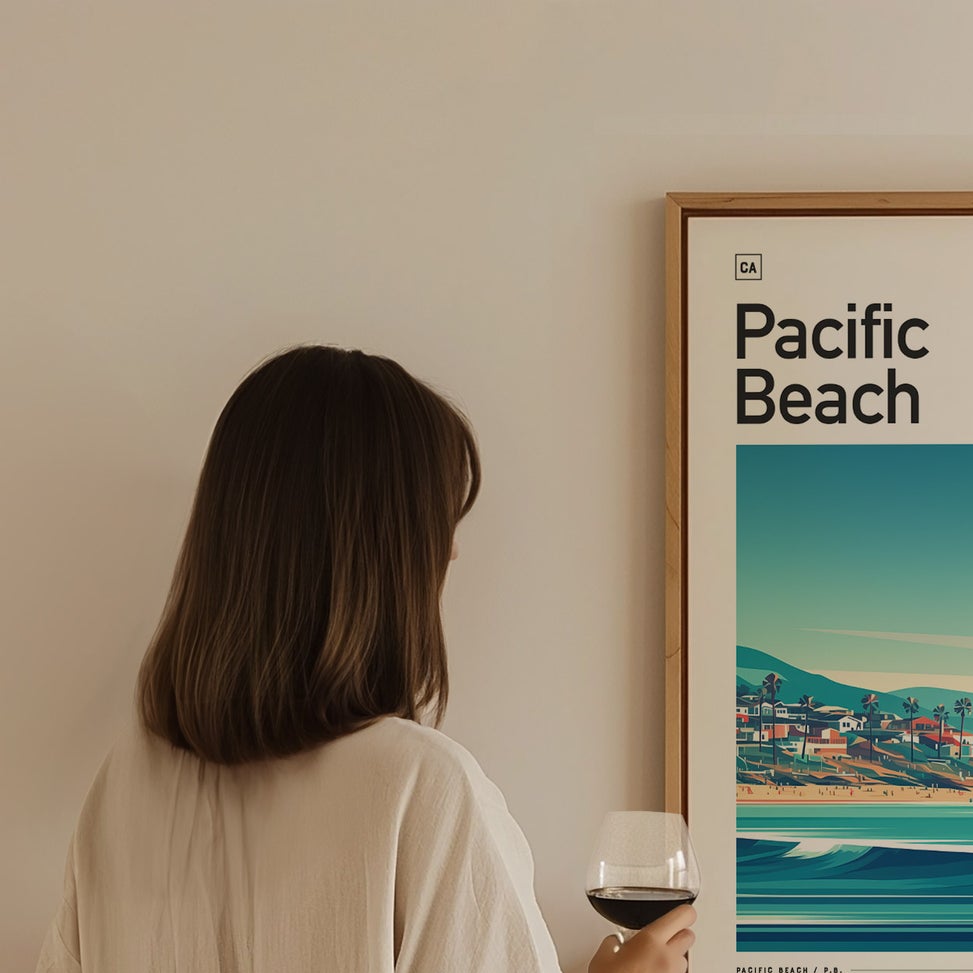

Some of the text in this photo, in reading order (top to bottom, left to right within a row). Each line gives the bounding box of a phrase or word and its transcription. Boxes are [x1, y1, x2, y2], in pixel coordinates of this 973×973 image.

[740, 261, 757, 274] CA
[737, 303, 929, 359] Pacific
[737, 368, 919, 424] Beach
